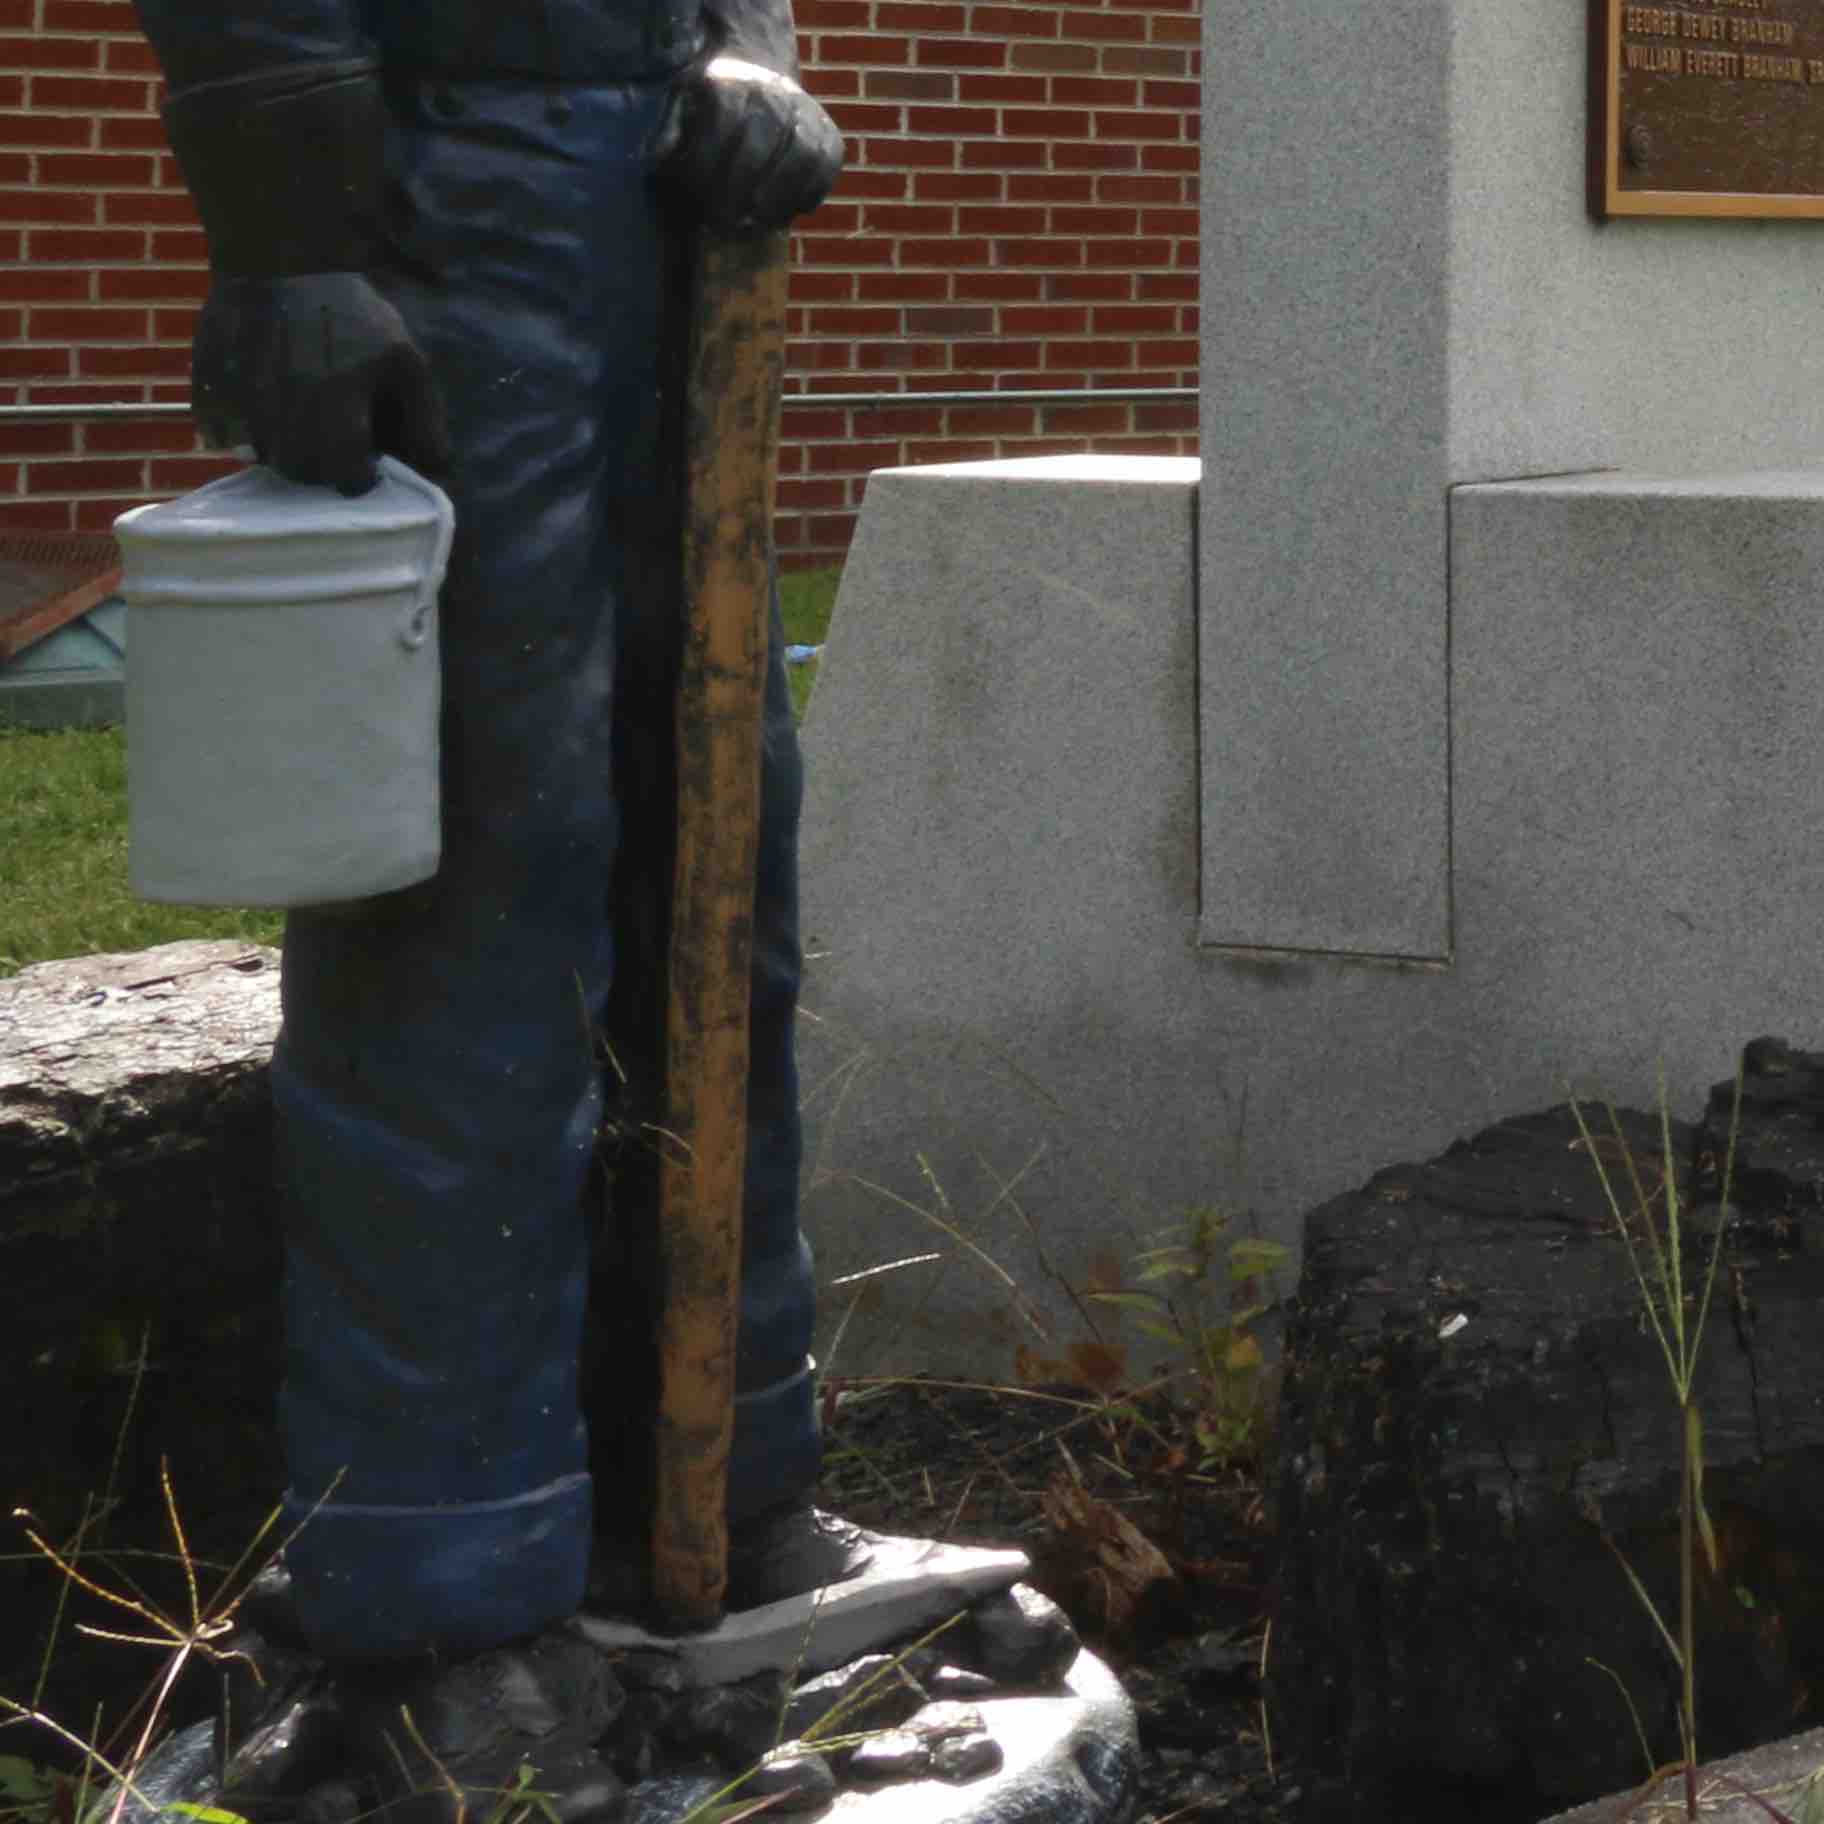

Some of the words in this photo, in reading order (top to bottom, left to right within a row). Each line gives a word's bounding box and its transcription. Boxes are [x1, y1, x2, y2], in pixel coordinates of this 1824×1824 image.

[1627, 7, 1676, 37] GEORGE
[1627, 45, 1681, 74] WILLIAM
[1686, 50, 1739, 78] EVERETT
